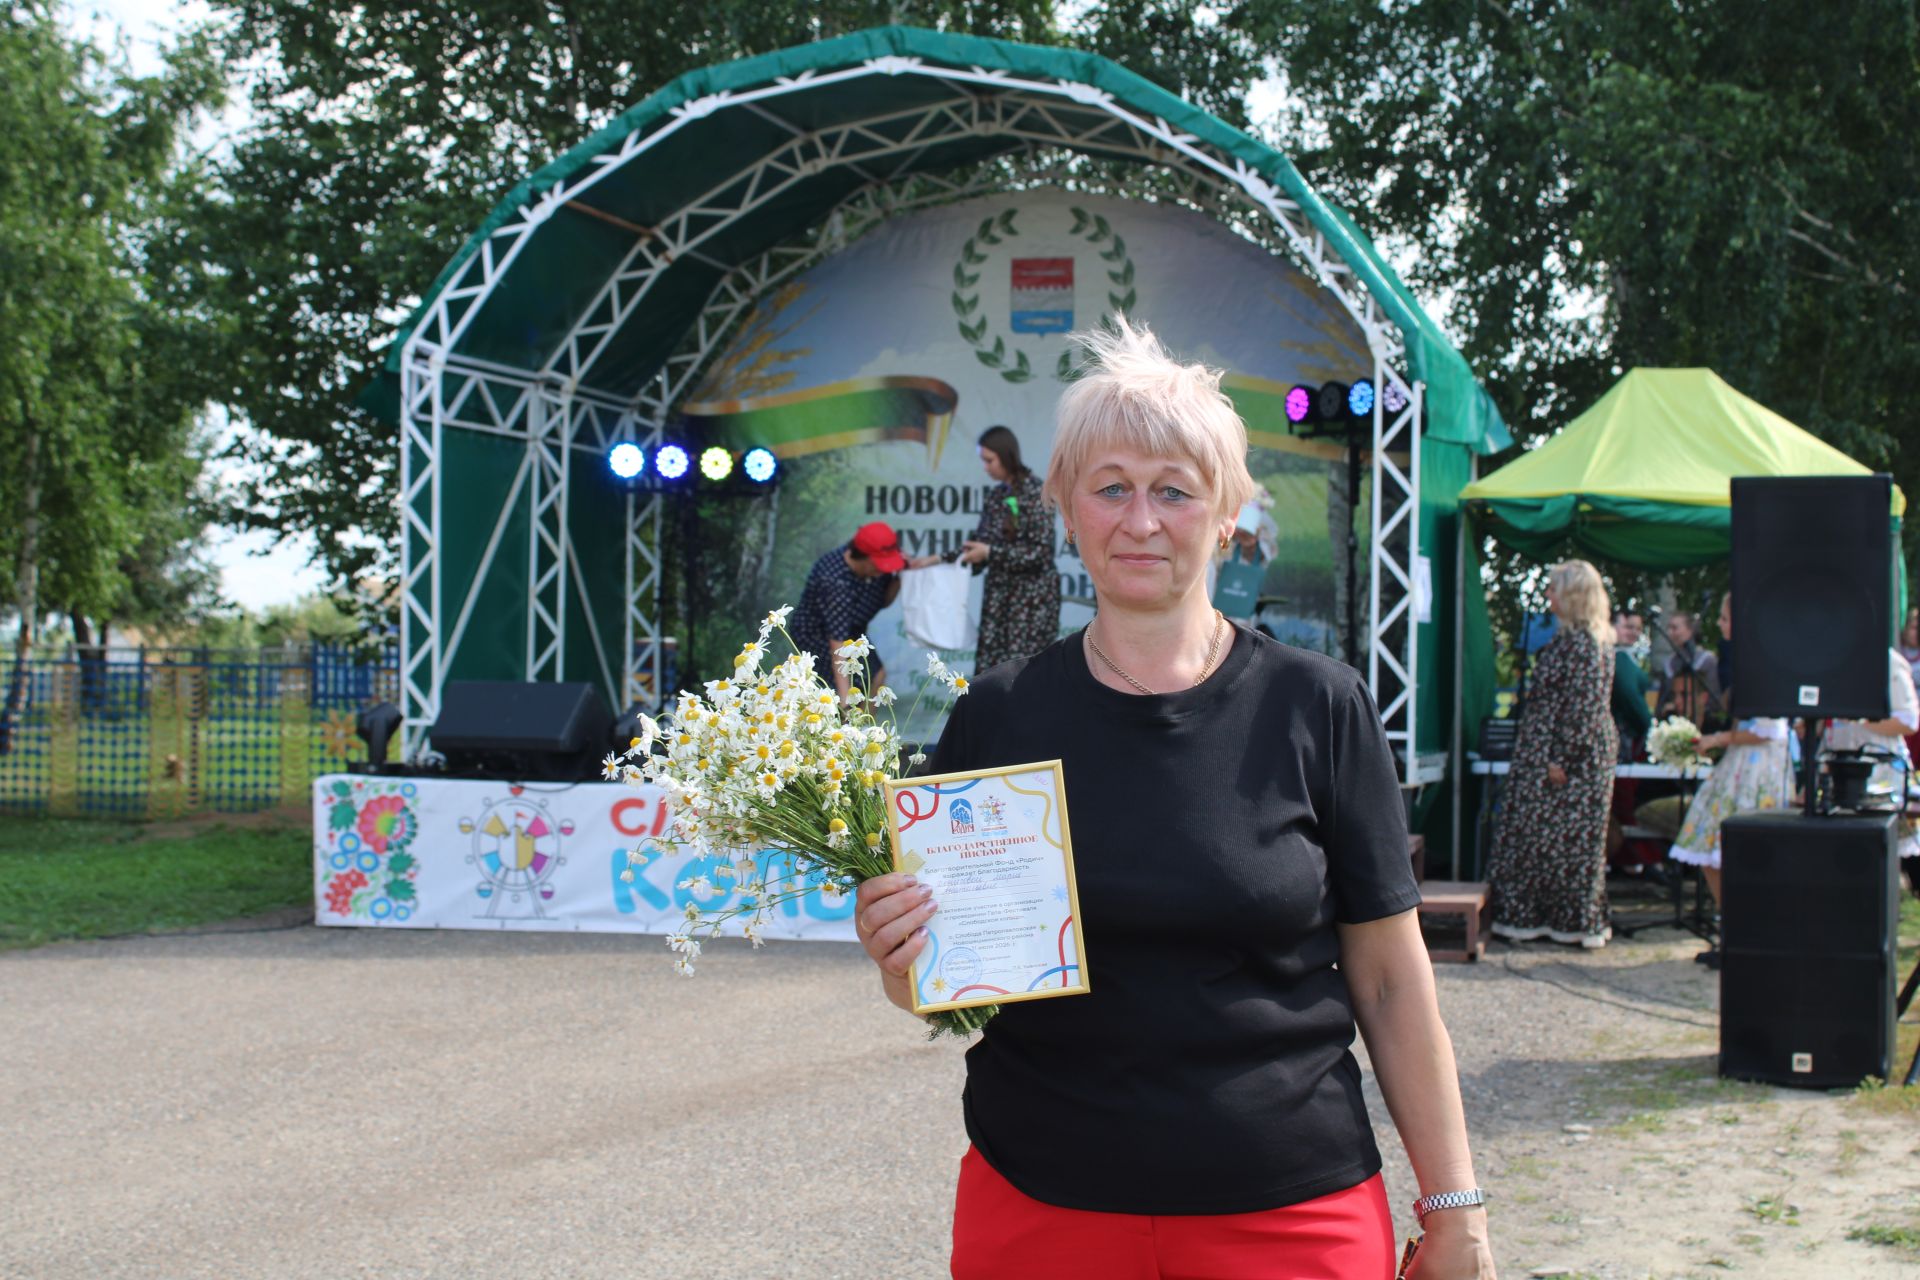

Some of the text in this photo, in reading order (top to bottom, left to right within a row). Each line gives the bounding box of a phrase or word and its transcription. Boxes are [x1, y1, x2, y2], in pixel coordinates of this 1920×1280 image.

[926, 834, 1038, 855] БЛАГОДАРСТВЕННОЕ
[960, 847, 1007, 859] ПИСЬМО
[924, 861, 994, 875] Благотворительный
[994, 859, 1015, 867] Фонд
